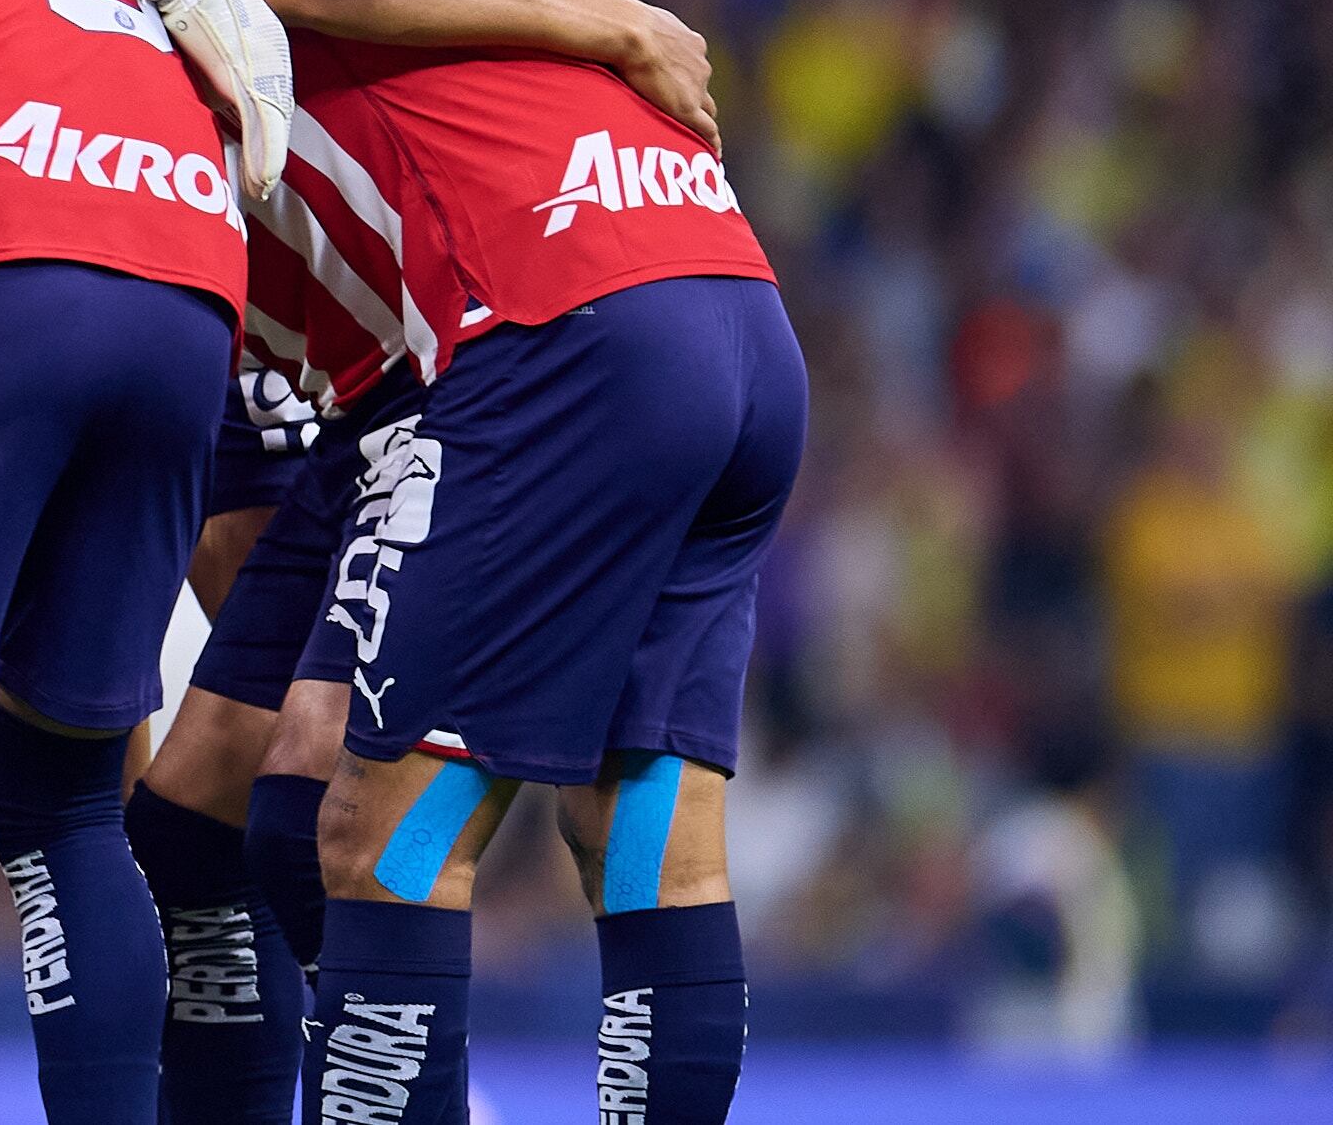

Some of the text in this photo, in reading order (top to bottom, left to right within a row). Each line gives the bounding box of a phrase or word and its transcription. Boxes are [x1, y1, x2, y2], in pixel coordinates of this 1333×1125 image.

[532, 129, 743, 239] AKRO
[4, 849, 77, 1016] PERDURA
[171, 904, 264, 1024] PERDURA
[321, 1003, 436, 1125] RDURA
[597, 987, 654, 1125] ERDURA
